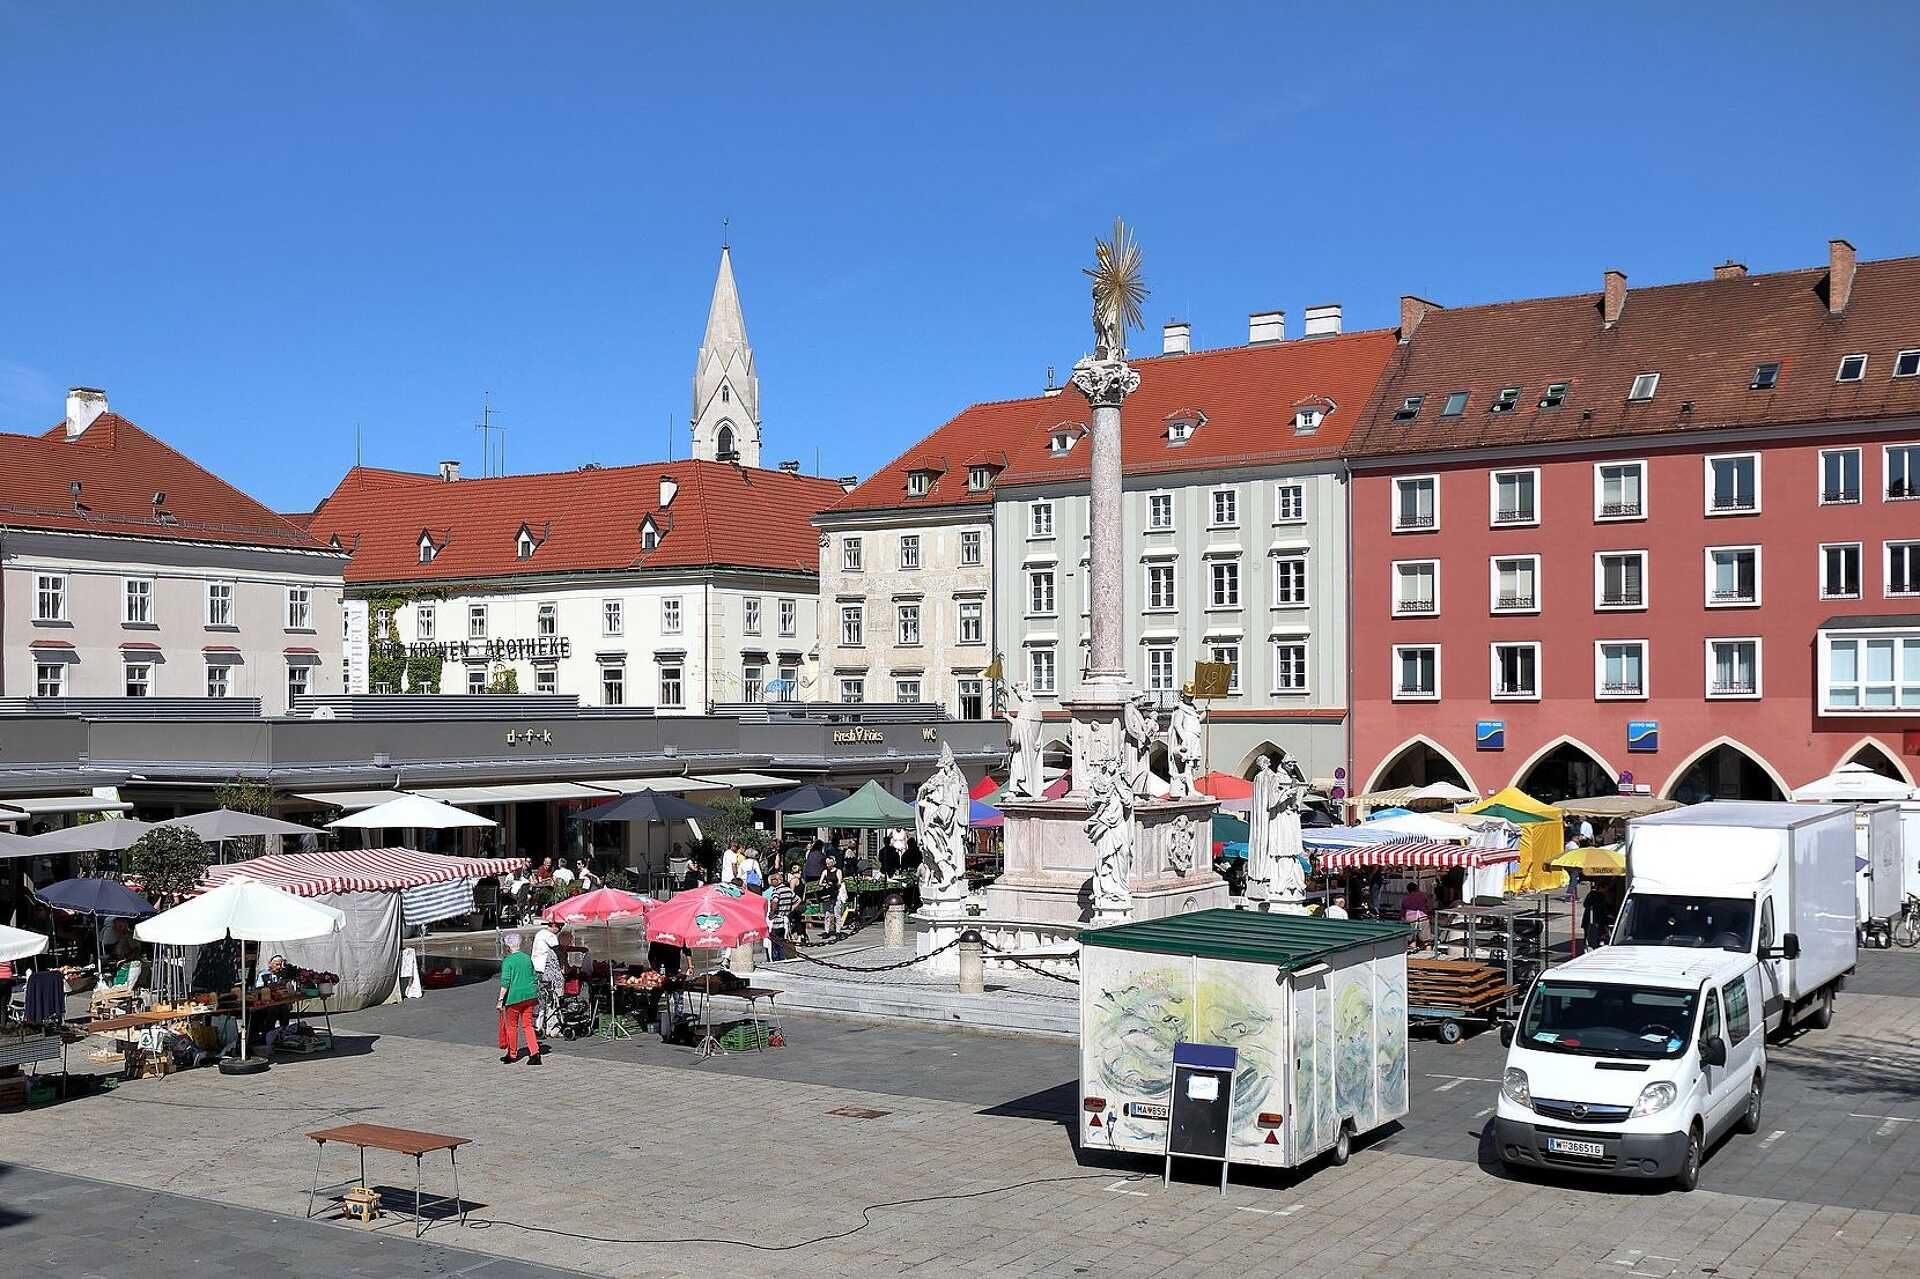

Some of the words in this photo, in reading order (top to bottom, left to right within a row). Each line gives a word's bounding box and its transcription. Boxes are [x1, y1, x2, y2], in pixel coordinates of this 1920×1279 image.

[410, 640, 469, 657] KRONEN
[485, 637, 570, 656] APOTHEKE
[922, 727, 937, 740] WC
